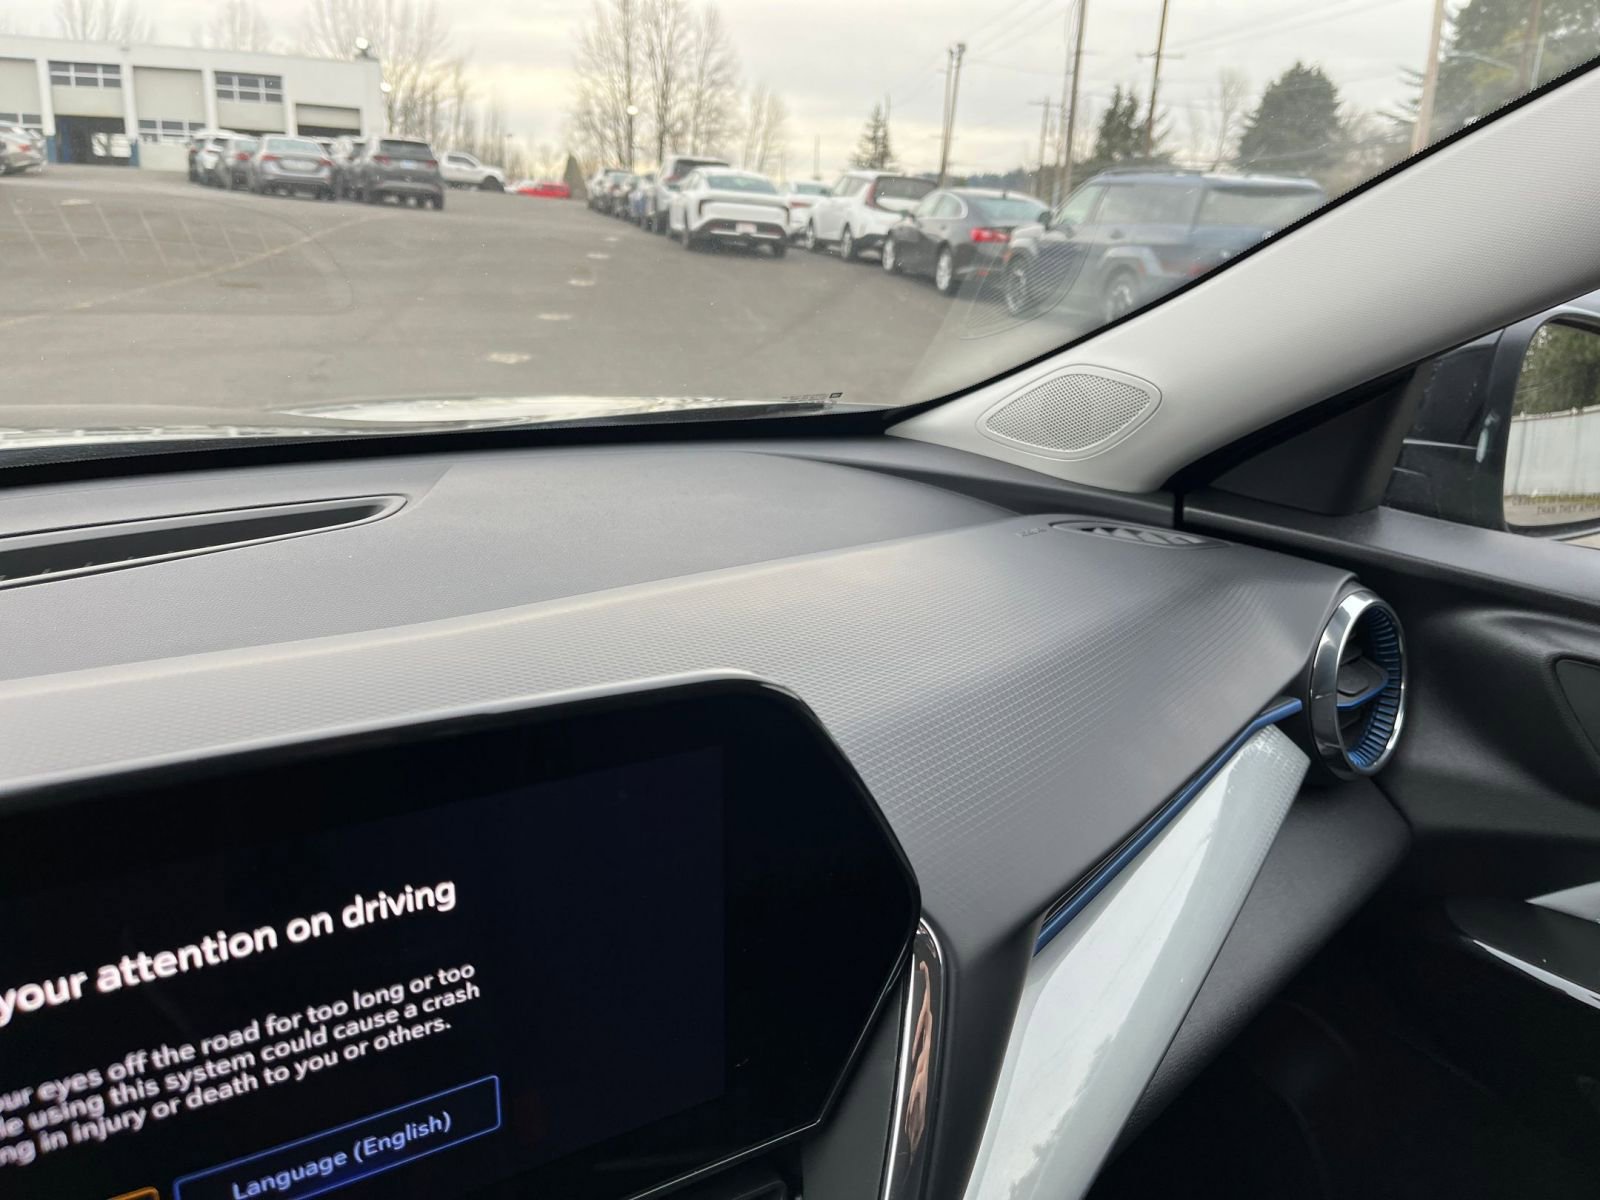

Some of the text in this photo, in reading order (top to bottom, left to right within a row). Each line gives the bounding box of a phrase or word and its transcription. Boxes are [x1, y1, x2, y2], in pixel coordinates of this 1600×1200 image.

[0, 881, 457, 1027] your attention on driving
[27, 1094, 105, 1131] using
[108, 1078, 160, 1106] this
[164, 1051, 256, 1092] system
[260, 1024, 328, 1062] could
[332, 1008, 400, 1040] cause
[403, 1003, 418, 1019] a
[421, 981, 481, 1013] crash
[37, 1067, 104, 1104] eyes
[107, 1049, 148, 1081] off
[151, 1043, 196, 1069] the
[200, 1019, 261, 1055] road
[265, 1013, 303, 1036] for
[305, 1000, 349, 1024] too
[352, 984, 405, 1011] long
[408, 974, 434, 994] or
[437, 964, 476, 986] too
[38, 1129, 69, 1153] in
[70, 1106, 148, 1143] injury
[151, 1097, 181, 1119] or
[185, 1070, 259, 1109] death
[263, 1066, 290, 1085] to
[293, 1050, 339, 1081] you
[343, 1040, 370, 1061] or
[373, 1017, 452, 1051] others.
[232, 1111, 452, 1200] Language (English)
